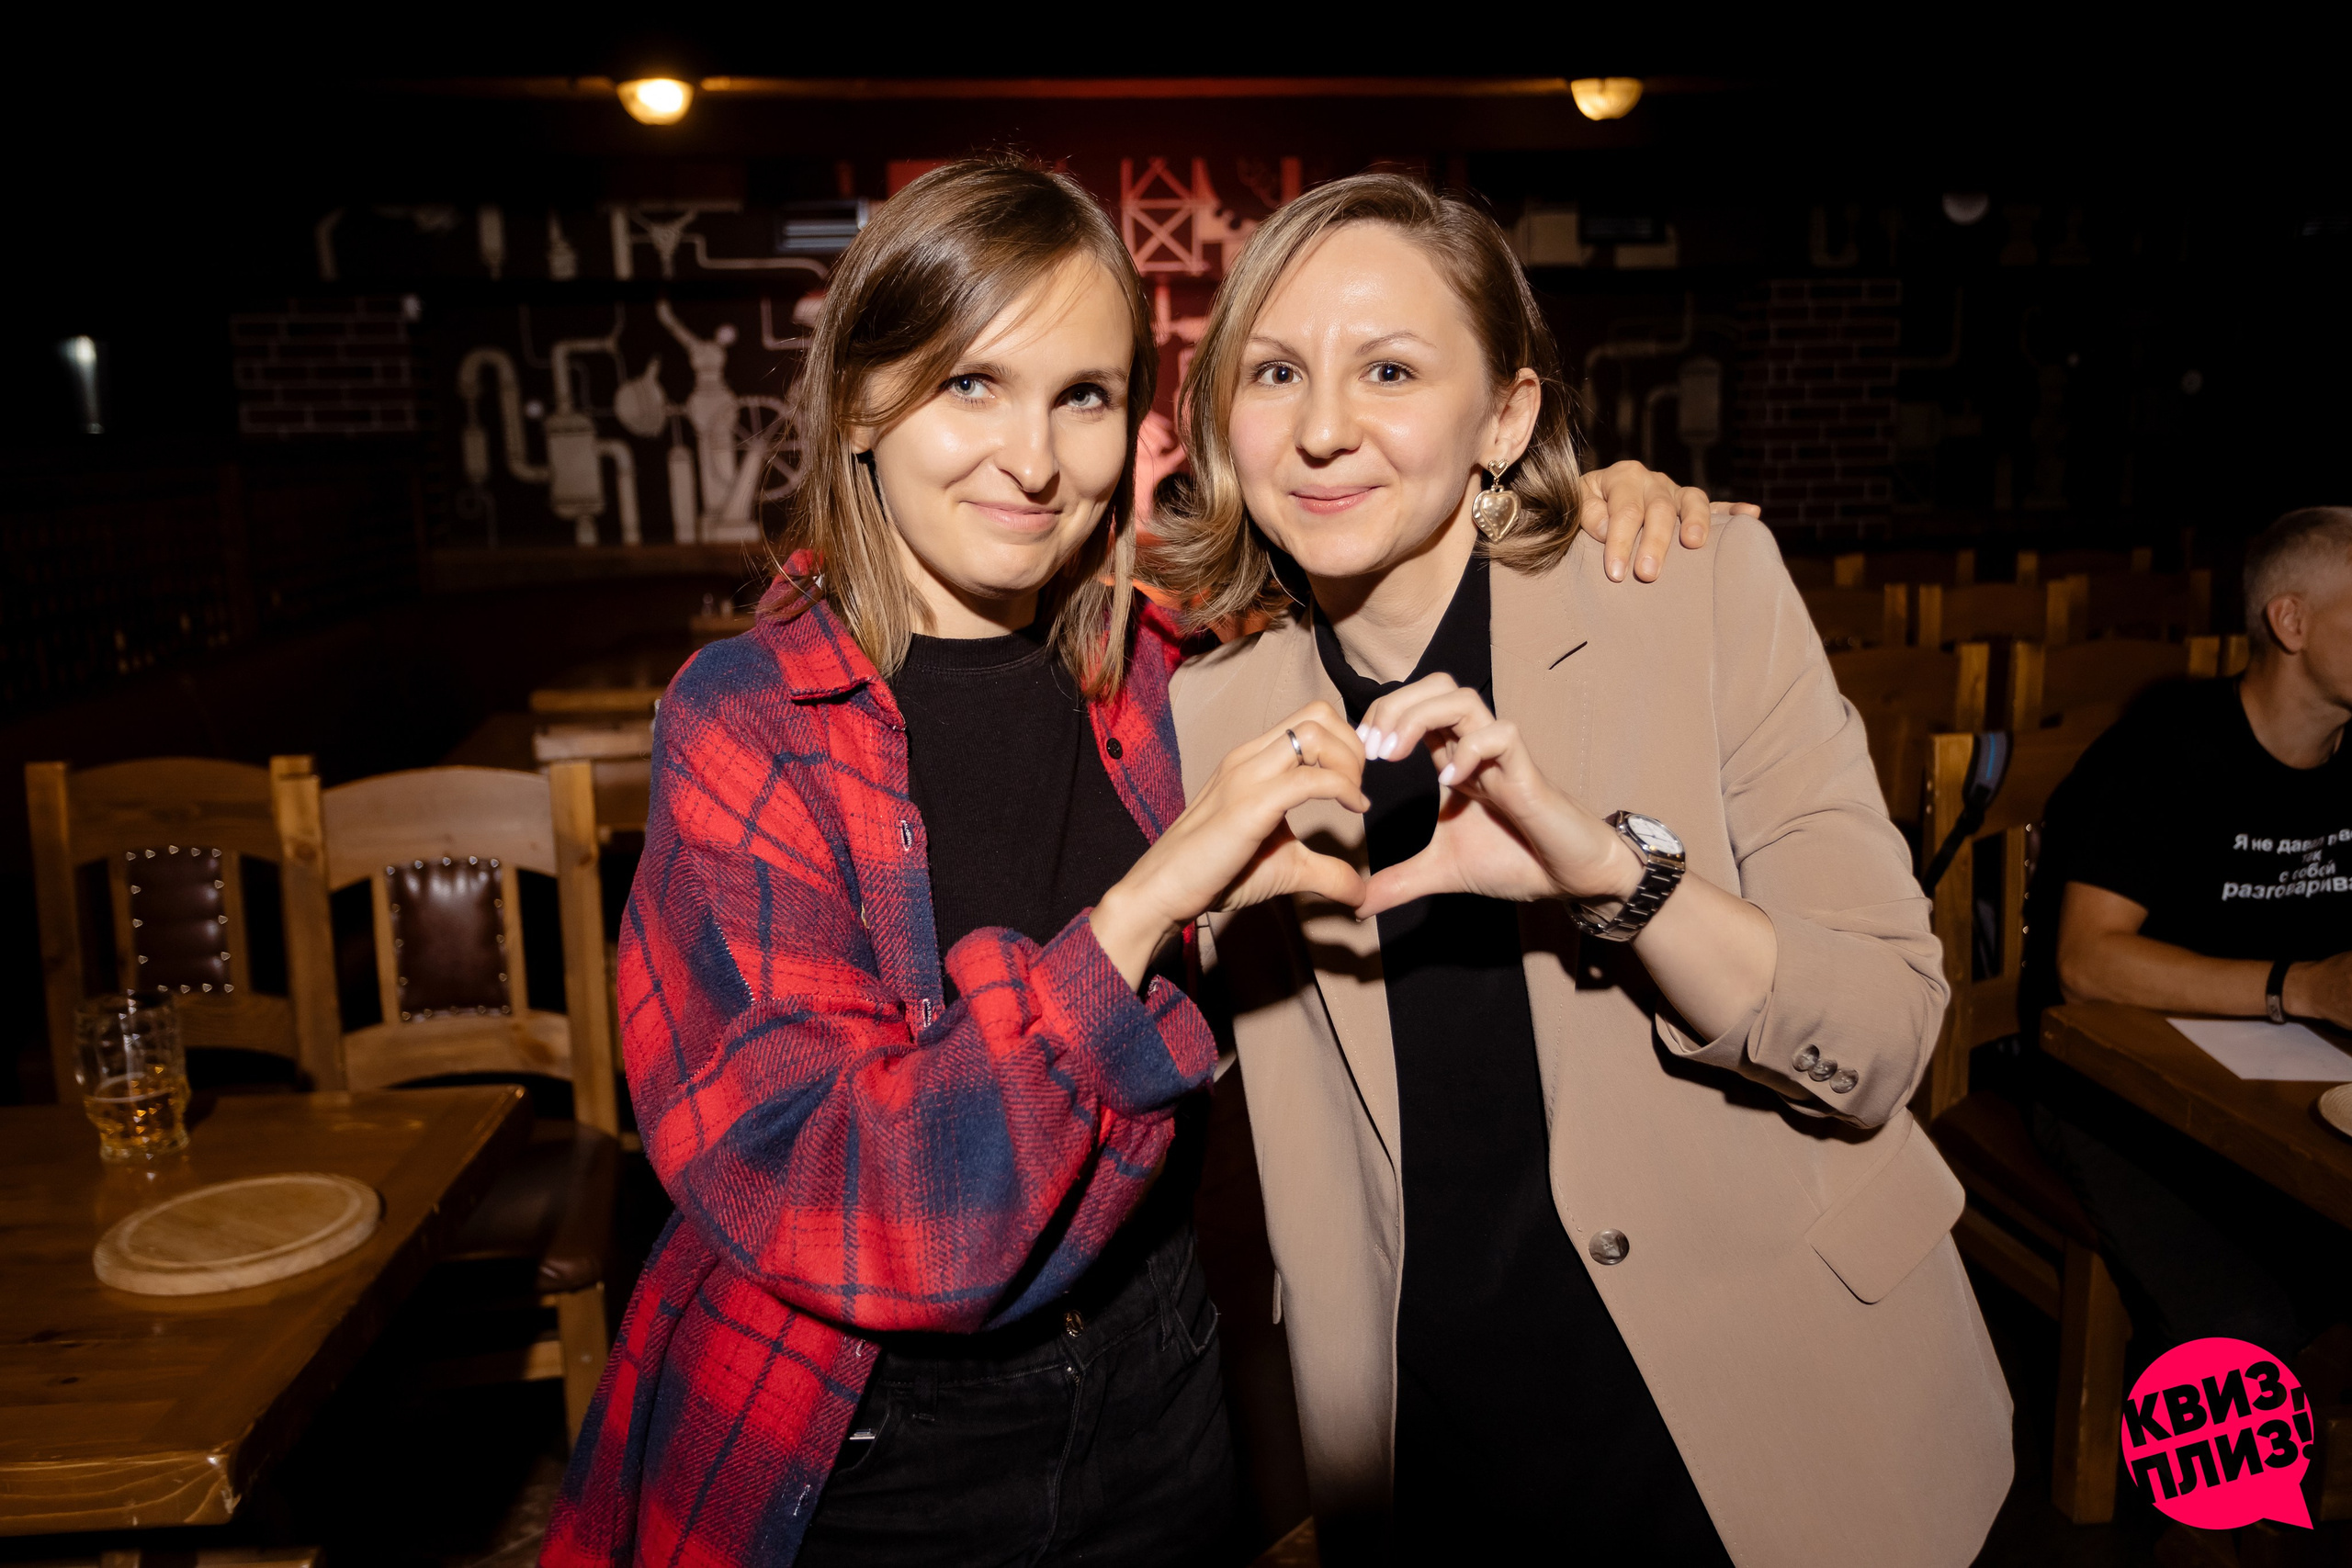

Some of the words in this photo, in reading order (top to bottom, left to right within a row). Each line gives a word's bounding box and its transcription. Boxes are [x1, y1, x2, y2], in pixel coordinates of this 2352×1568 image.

[2233, 832, 2249, 852] Я
[2251, 838, 2275, 852] не
[2278, 870, 2290, 883] с
